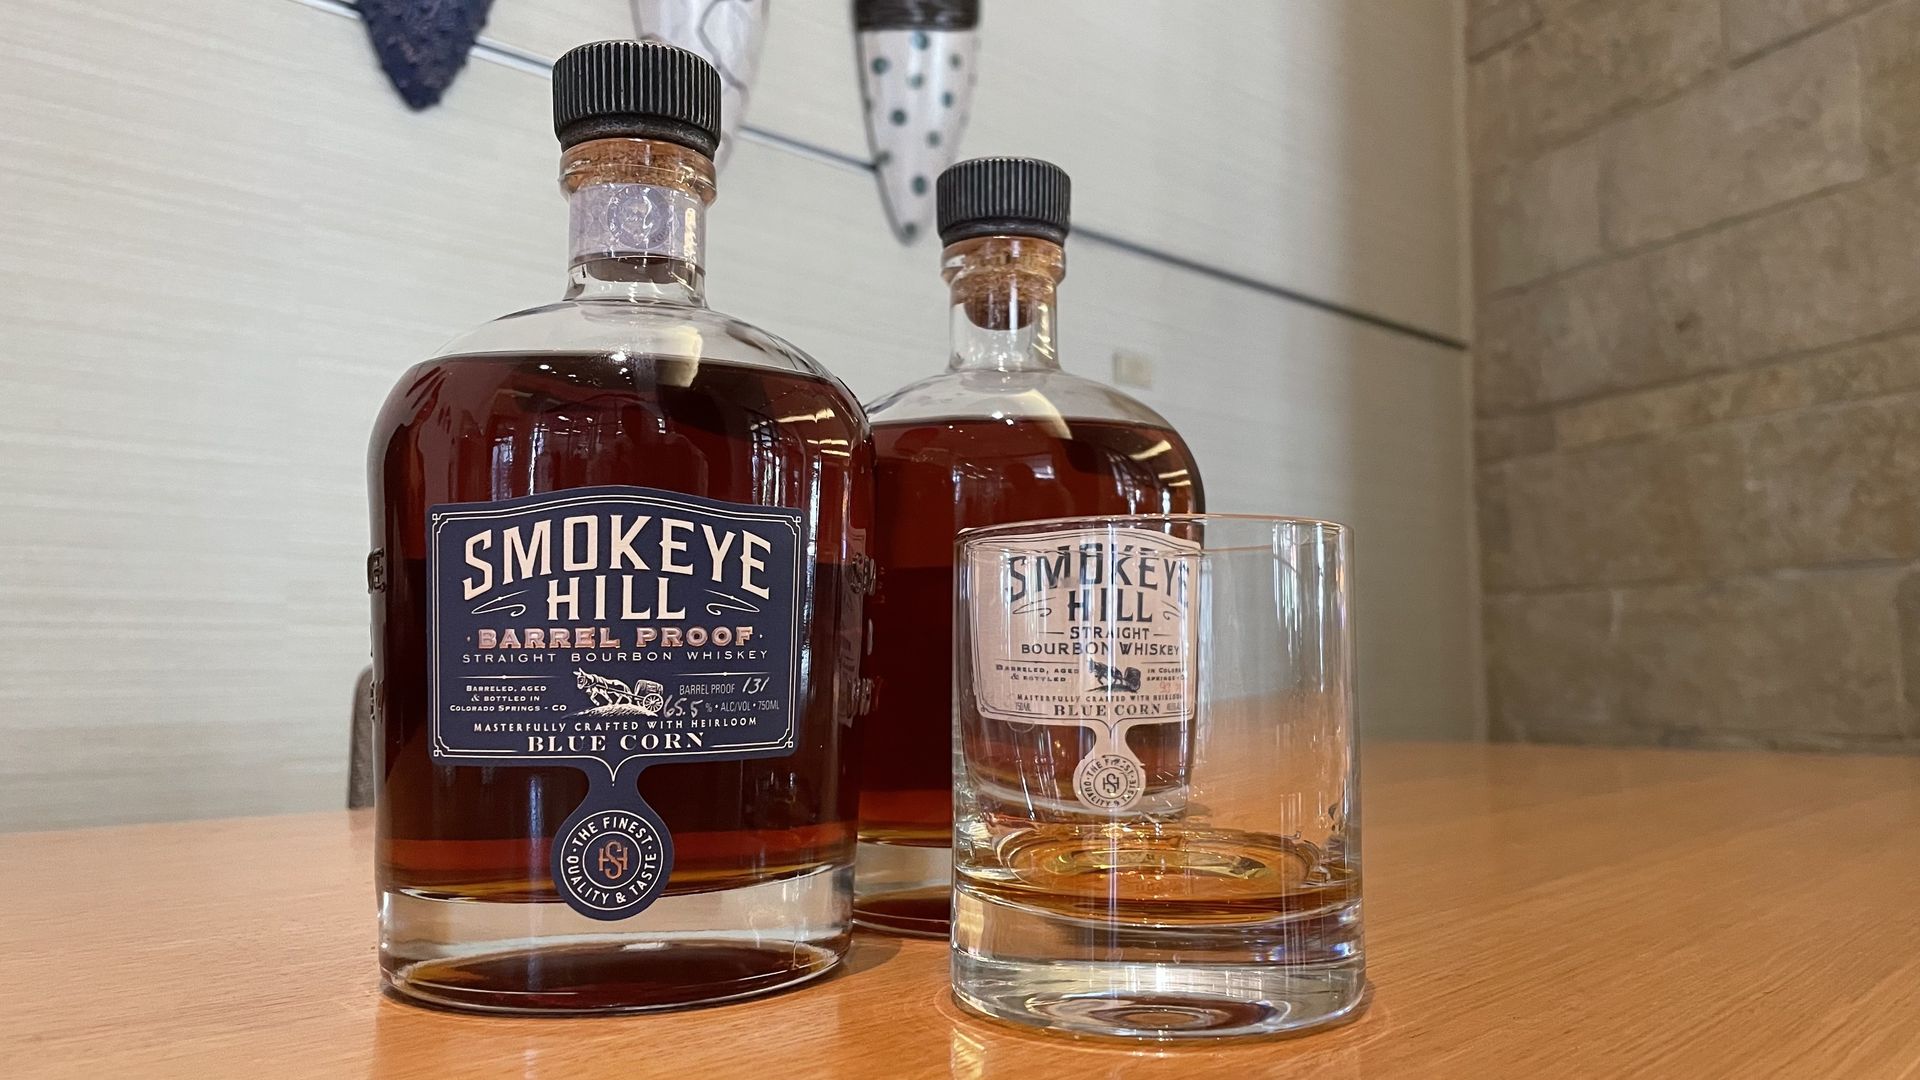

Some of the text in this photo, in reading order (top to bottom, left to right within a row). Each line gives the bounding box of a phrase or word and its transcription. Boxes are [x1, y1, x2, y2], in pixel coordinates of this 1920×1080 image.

[462, 514, 771, 601] SMOKEYE
[546, 575, 686, 620] HILL
[1067, 587, 1153, 623] HILL
[477, 626, 754, 649] BARREL PROOF
[1070, 626, 1150, 641] STRAIGHT
[1021, 641, 1180, 656] BOURBON WHISKEY
[462, 650, 768, 664] STRAIGHT BOURBON WHISKEY
[679, 683, 736, 695] BARREL PROOF
[471, 694, 480, 702] &
[720, 701, 751, 712] ALC/VOL
[757, 699, 780, 711] 750ML
[450, 704, 495, 712] COLORADO
[498, 704, 541, 712] SPRINGS
[1054, 704, 1107, 717] BLUE
[1114, 704, 1160, 716] CORN
[473, 717, 757, 733] MASTERFULLY CRAFTED WITH HEIRLOOM
[528, 731, 704, 752] BLUE CORN
[1086, 761, 1103, 777] THE
[571, 816, 653, 847] THE FINEST
[566, 853, 657, 905] QUALITY & TASTE
